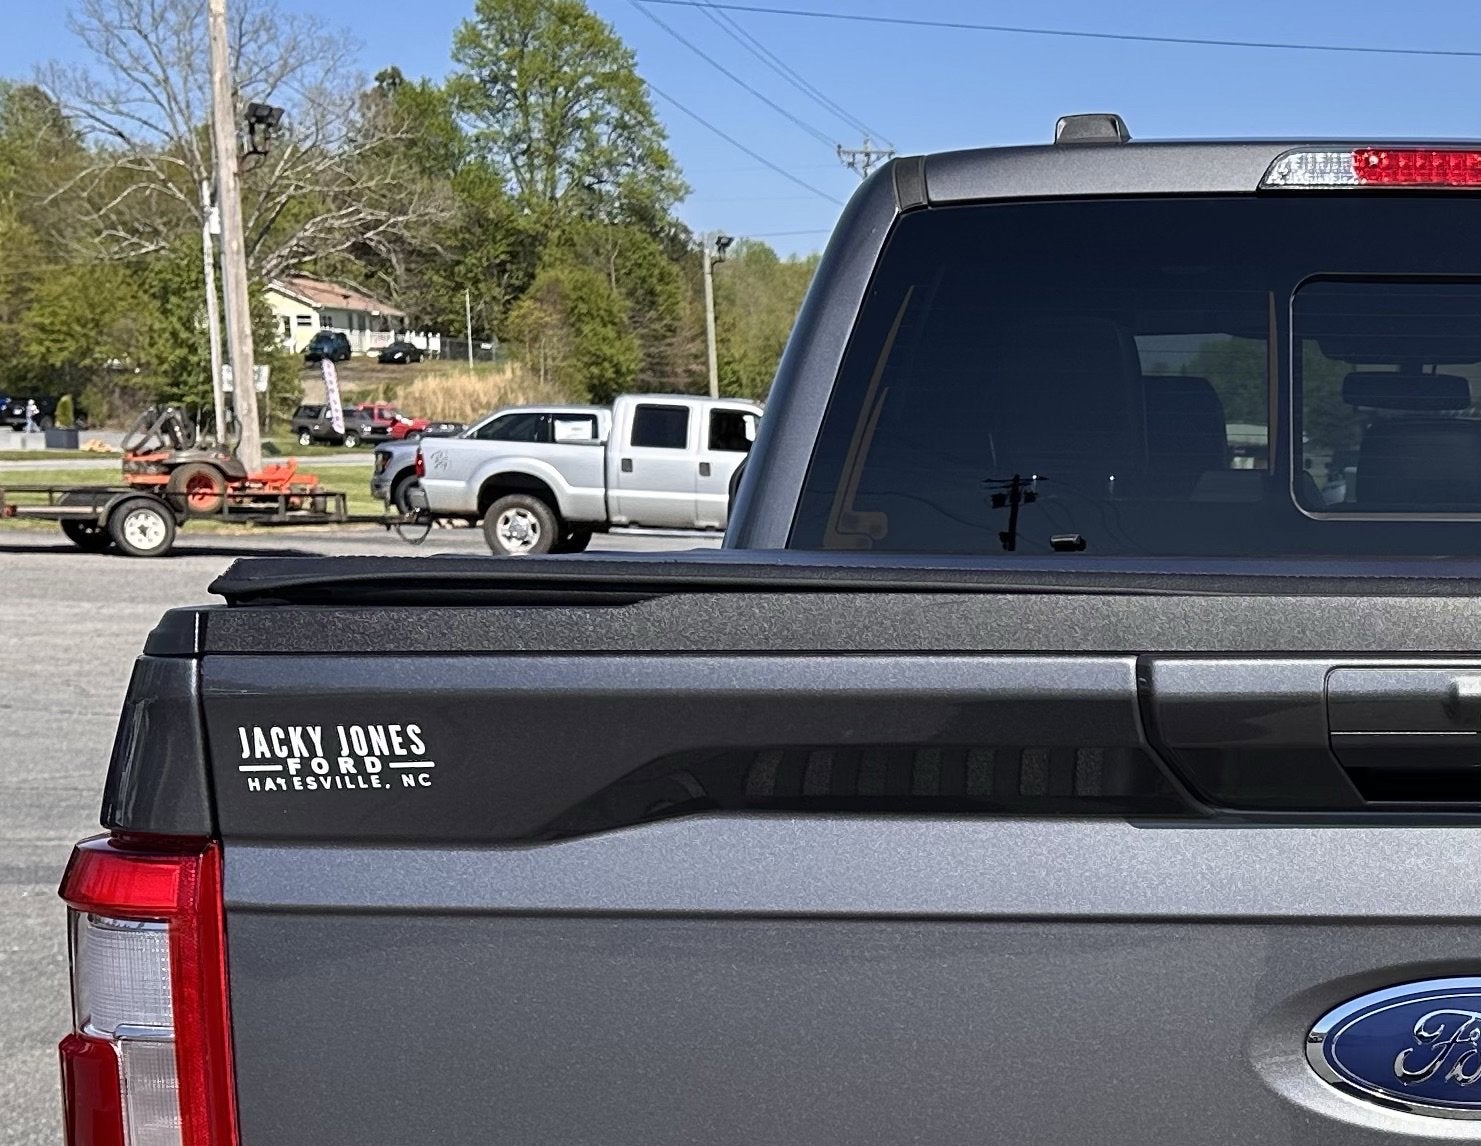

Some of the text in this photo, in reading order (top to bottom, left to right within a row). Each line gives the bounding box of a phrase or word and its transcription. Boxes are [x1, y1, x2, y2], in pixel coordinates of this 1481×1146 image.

[238, 724, 426, 759] JACKY JONES
[287, 756, 383, 775] FORD
[401, 773, 432, 788] NC
